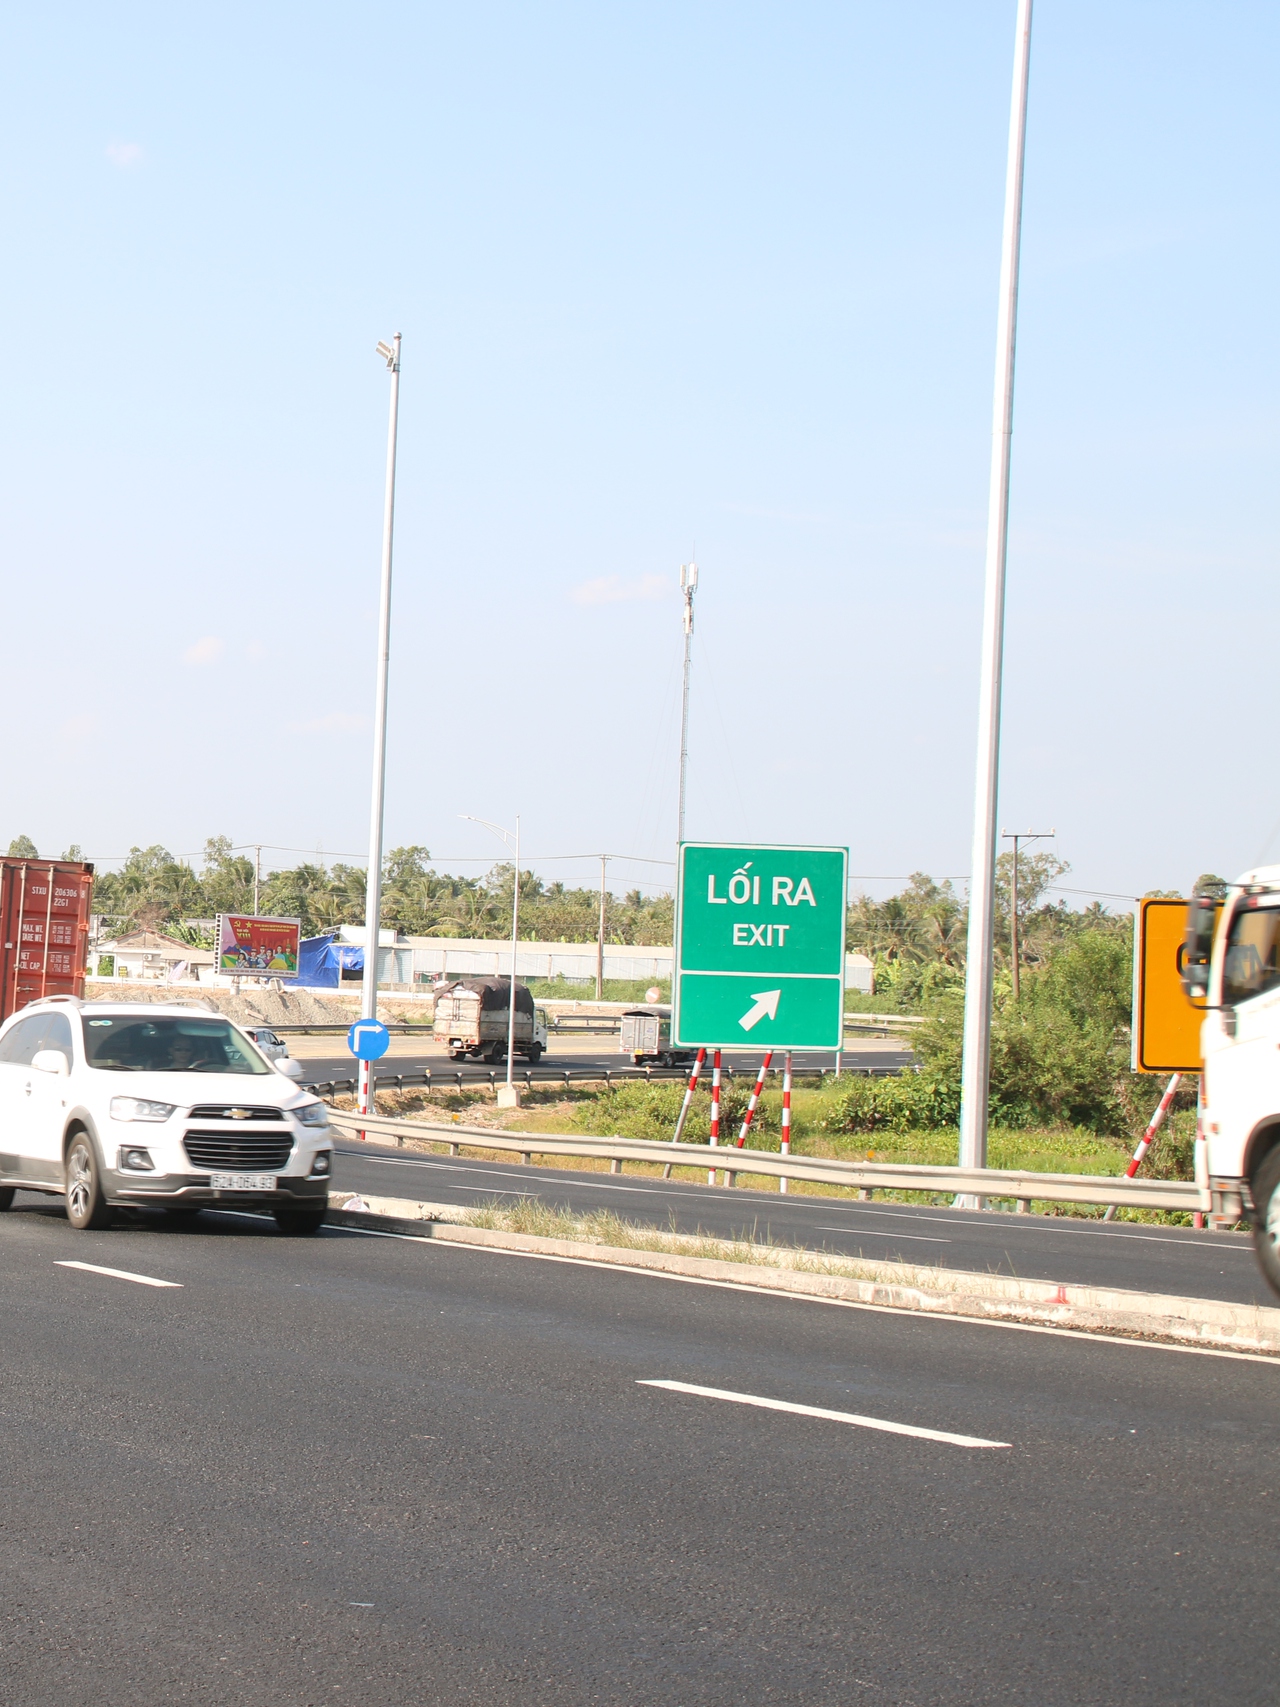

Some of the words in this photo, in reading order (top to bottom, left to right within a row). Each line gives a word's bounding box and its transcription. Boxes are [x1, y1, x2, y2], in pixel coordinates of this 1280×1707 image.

[31, 886, 47, 895] STXU
[54, 887, 78, 897] 206306
[707, 861, 761, 905] LỐI
[771, 876, 817, 907] RA
[732, 923, 790, 947] EXIT
